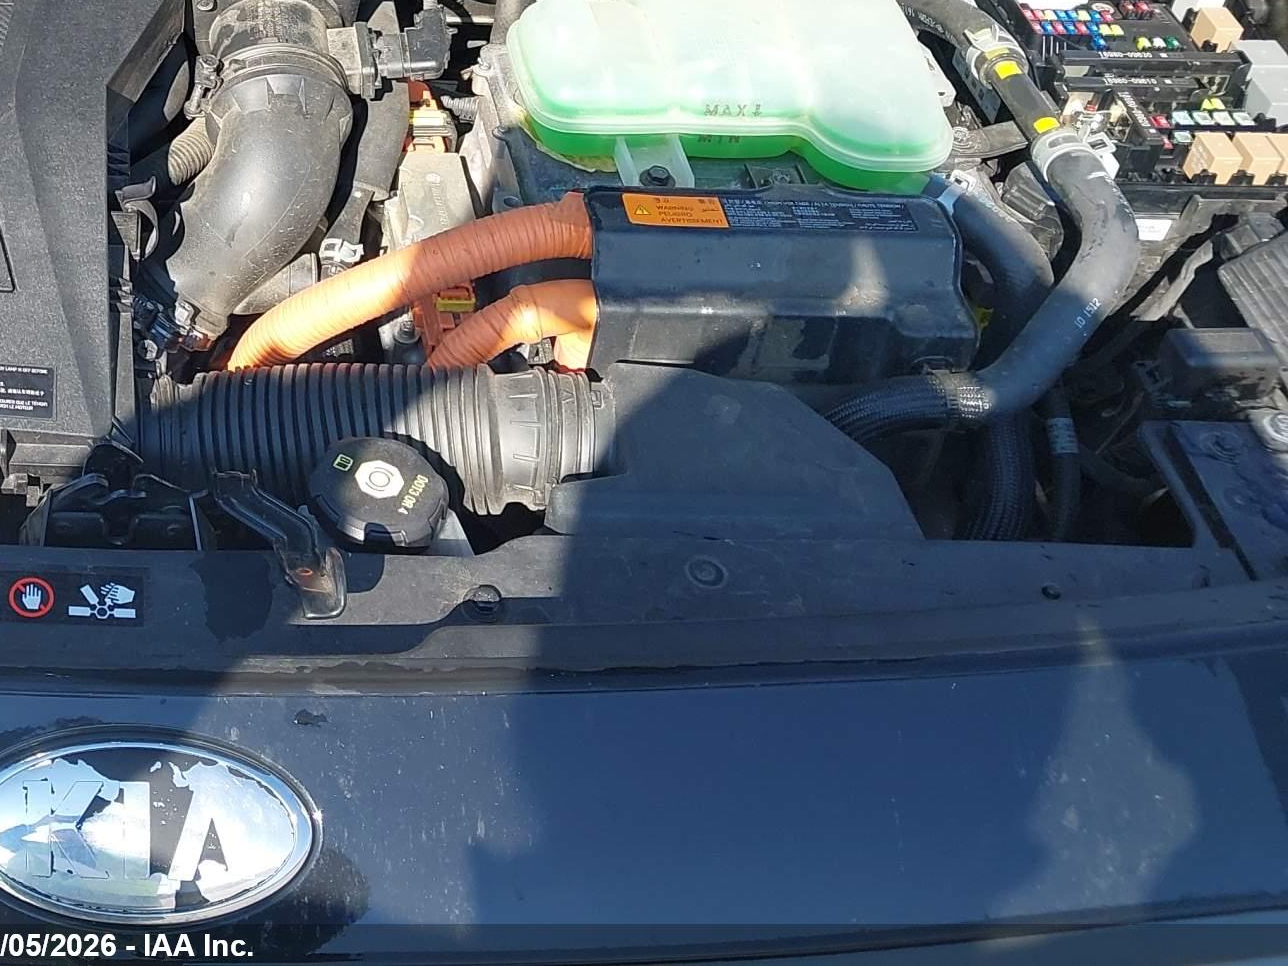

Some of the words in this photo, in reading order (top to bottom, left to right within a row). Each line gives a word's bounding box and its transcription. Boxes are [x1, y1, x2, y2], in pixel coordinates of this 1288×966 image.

[704, 104, 748, 117] MAX
[1083, 297, 1101, 317] 1512
[409, 474, 428, 496] DOT3
[401, 495, 416, 509] OR
[22, 779, 228, 882] KIA
